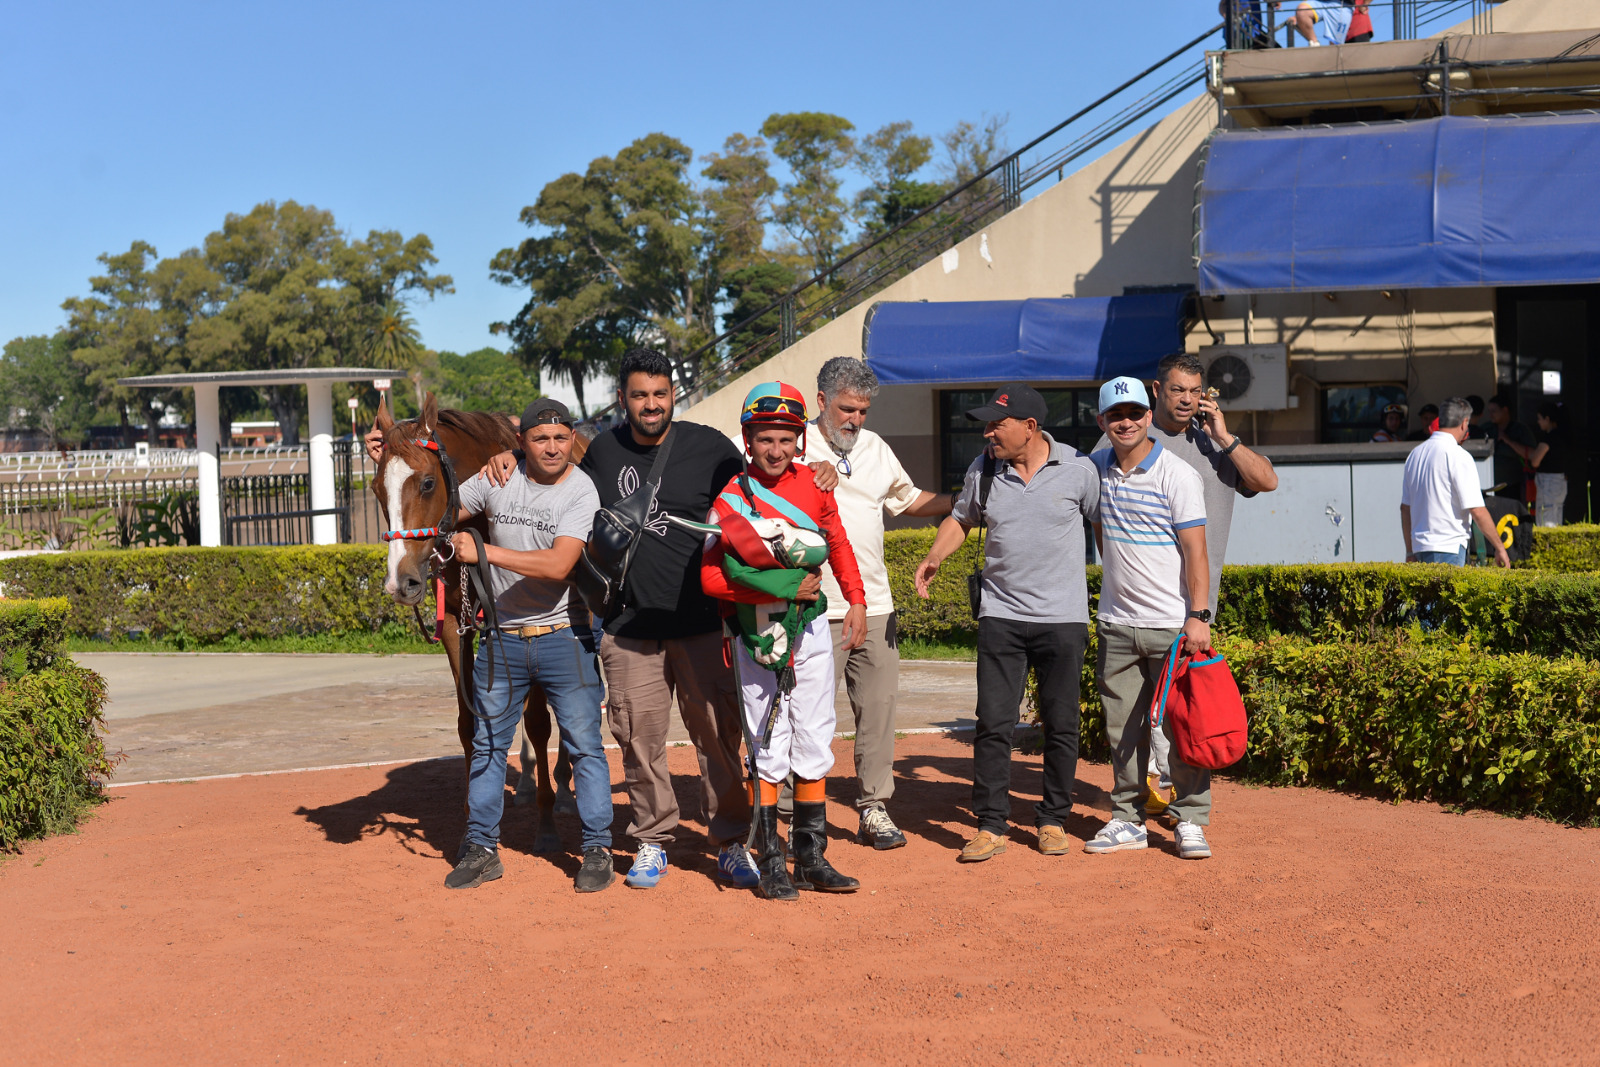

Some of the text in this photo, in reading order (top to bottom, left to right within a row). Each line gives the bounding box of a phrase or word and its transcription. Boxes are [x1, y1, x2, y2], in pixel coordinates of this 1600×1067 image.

[1114, 381, 1129, 395] NY
[494, 512, 532, 527] HOLDING
[537, 521, 558, 535] BAC
[1496, 513, 1520, 550] 6
